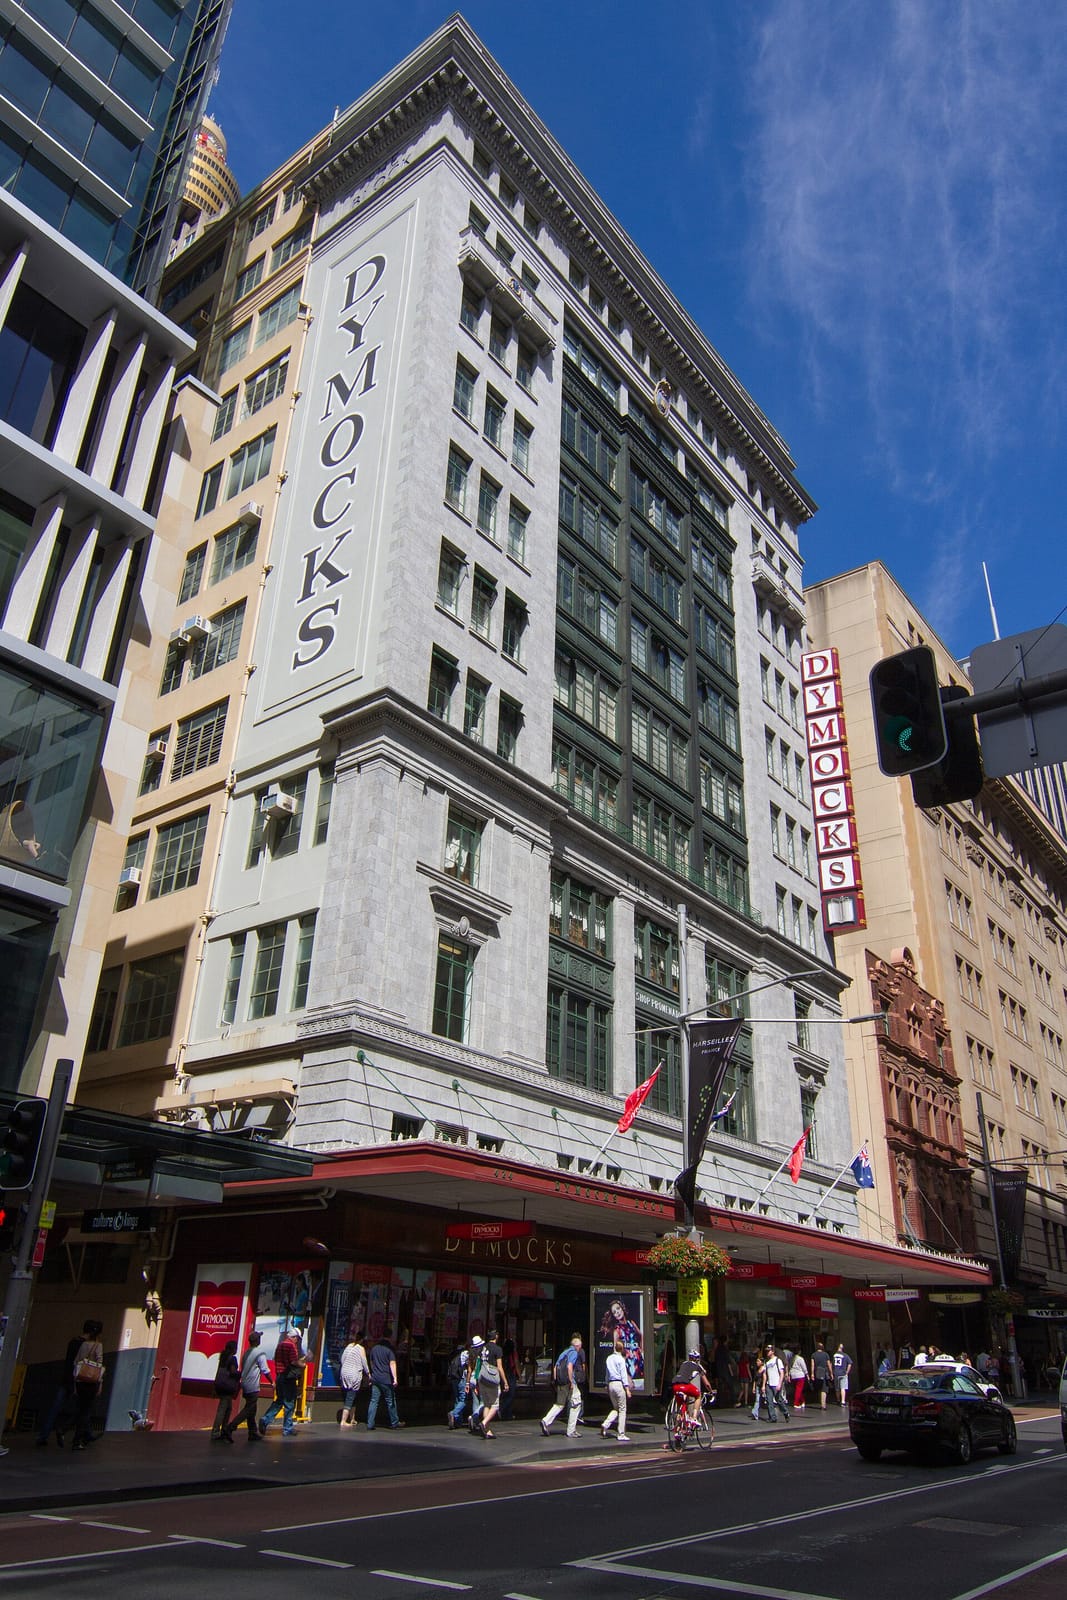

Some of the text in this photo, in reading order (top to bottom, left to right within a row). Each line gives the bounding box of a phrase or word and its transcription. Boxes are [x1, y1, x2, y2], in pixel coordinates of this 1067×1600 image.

[292, 254, 386, 671] DYMOCKS
[807, 655, 847, 886] DYMOCKS
[636, 992, 650, 1005] SHOP
[692, 1036, 735, 1048] MARSEILLES
[495, 1169, 513, 1180] 424
[555, 1181, 618, 1204] DYMOCKS
[474, 1225, 500, 1234] DYMOCKS
[201, 1314, 234, 1325] DYMOCKS
